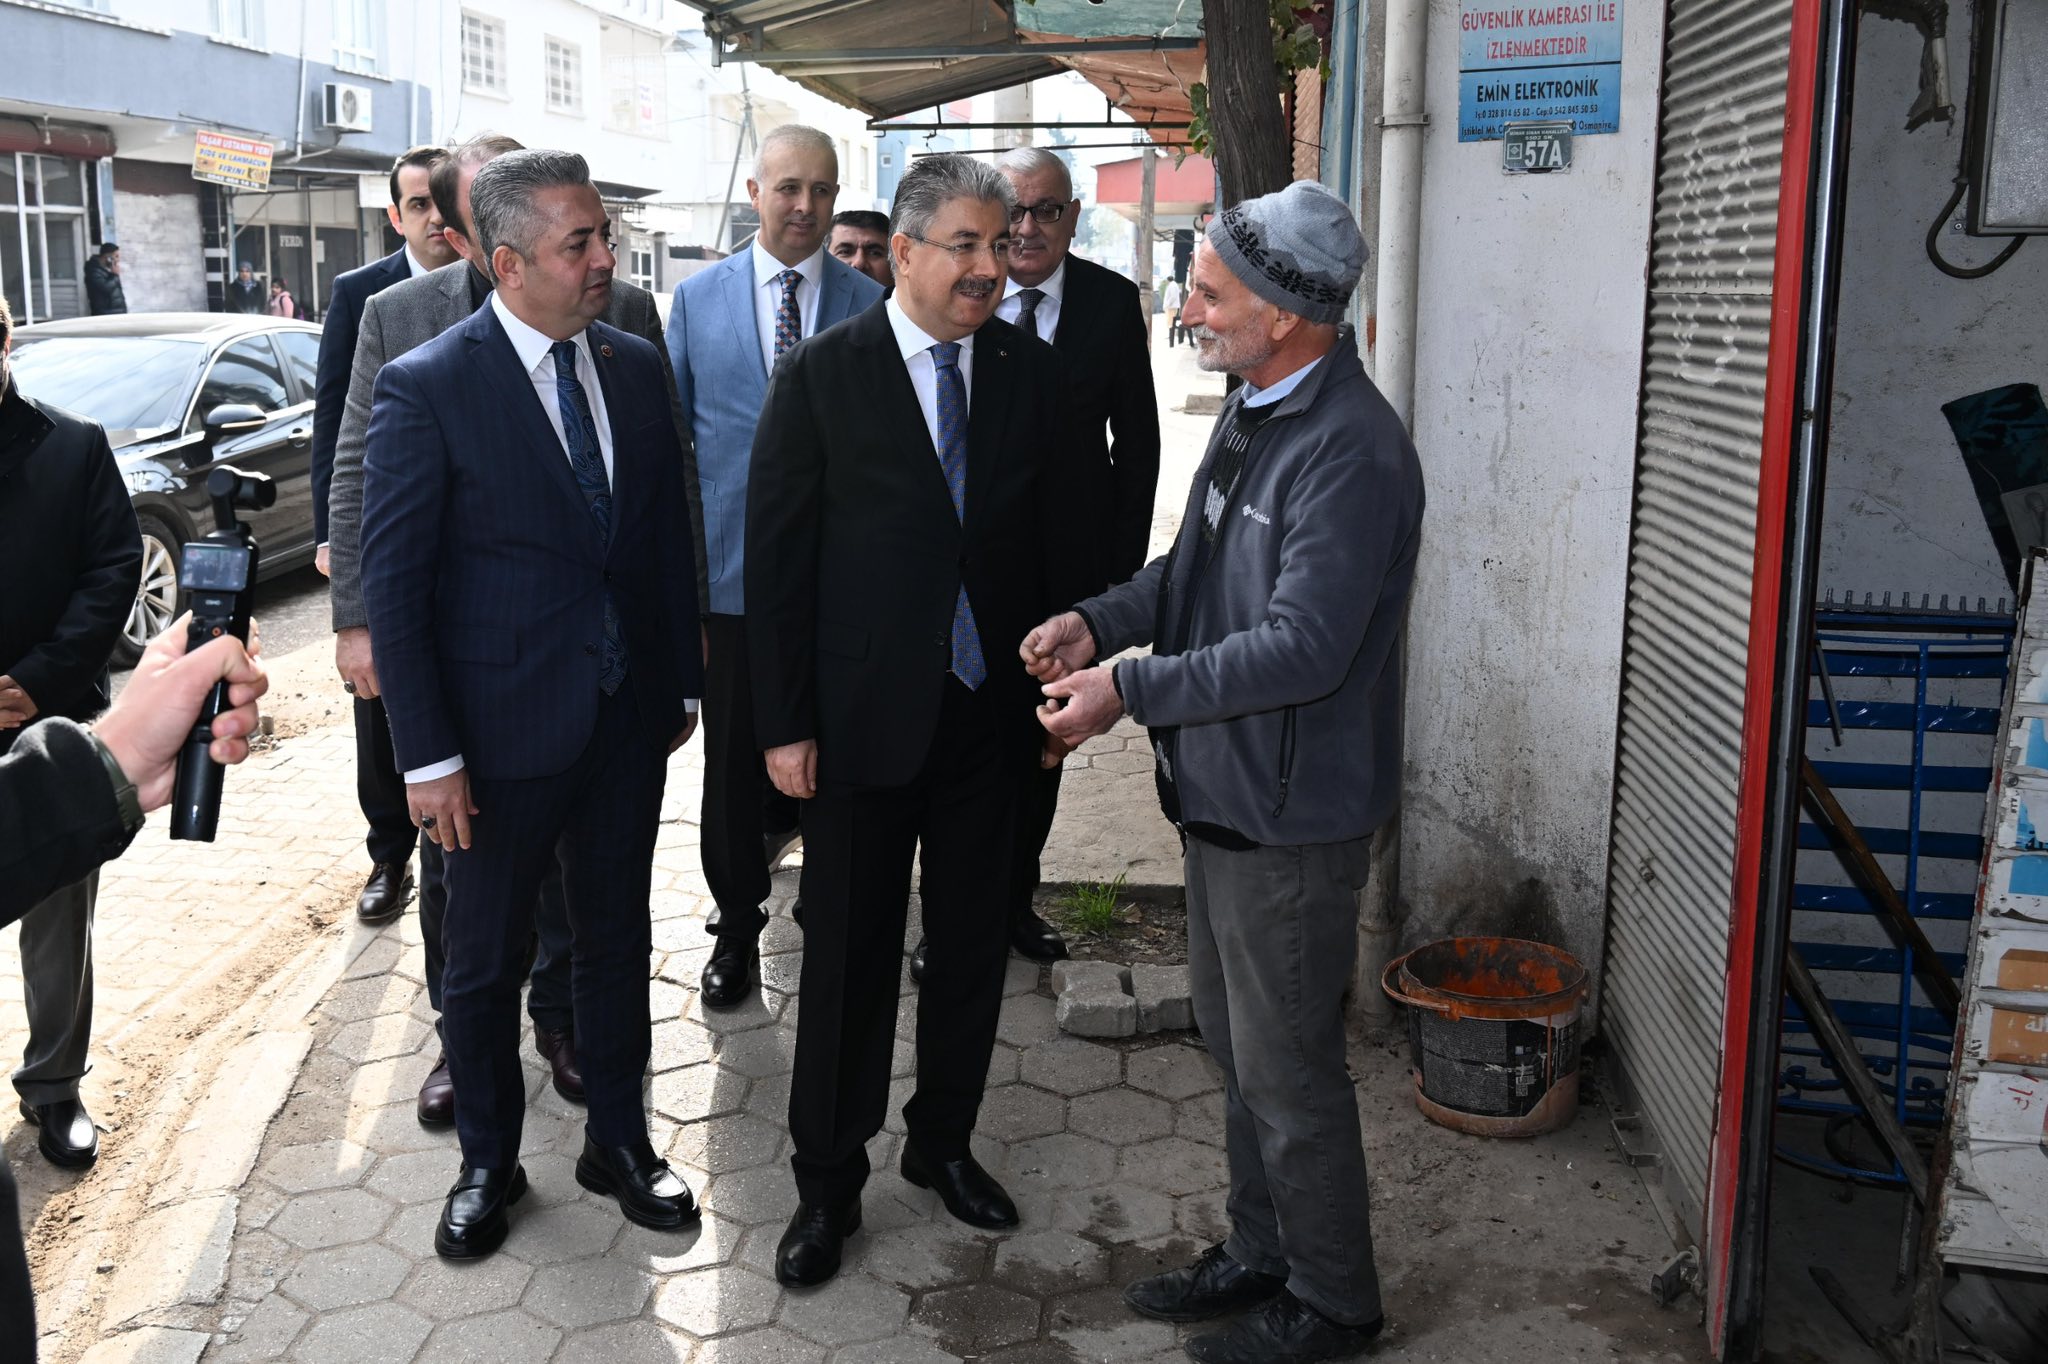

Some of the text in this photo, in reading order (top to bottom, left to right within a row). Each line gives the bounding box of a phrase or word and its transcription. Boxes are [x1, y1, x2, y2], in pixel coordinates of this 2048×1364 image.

[1462, 0, 1616, 32] GÜVENLİK KAMERASI İLE
[1487, 32, 1587, 60] İZLENMEKTEDİR
[1477, 75, 1599, 103] EMİN ELEKTRONİK
[1488, 109, 1499, 118] 328
[1500, 108, 1512, 117] 814
[1554, 105, 1566, 115] 542
[1568, 104, 1579, 114] 845
[1580, 104, 1588, 113] 50
[1590, 103, 1598, 113] 53
[1524, 140, 1563, 167] 57A
